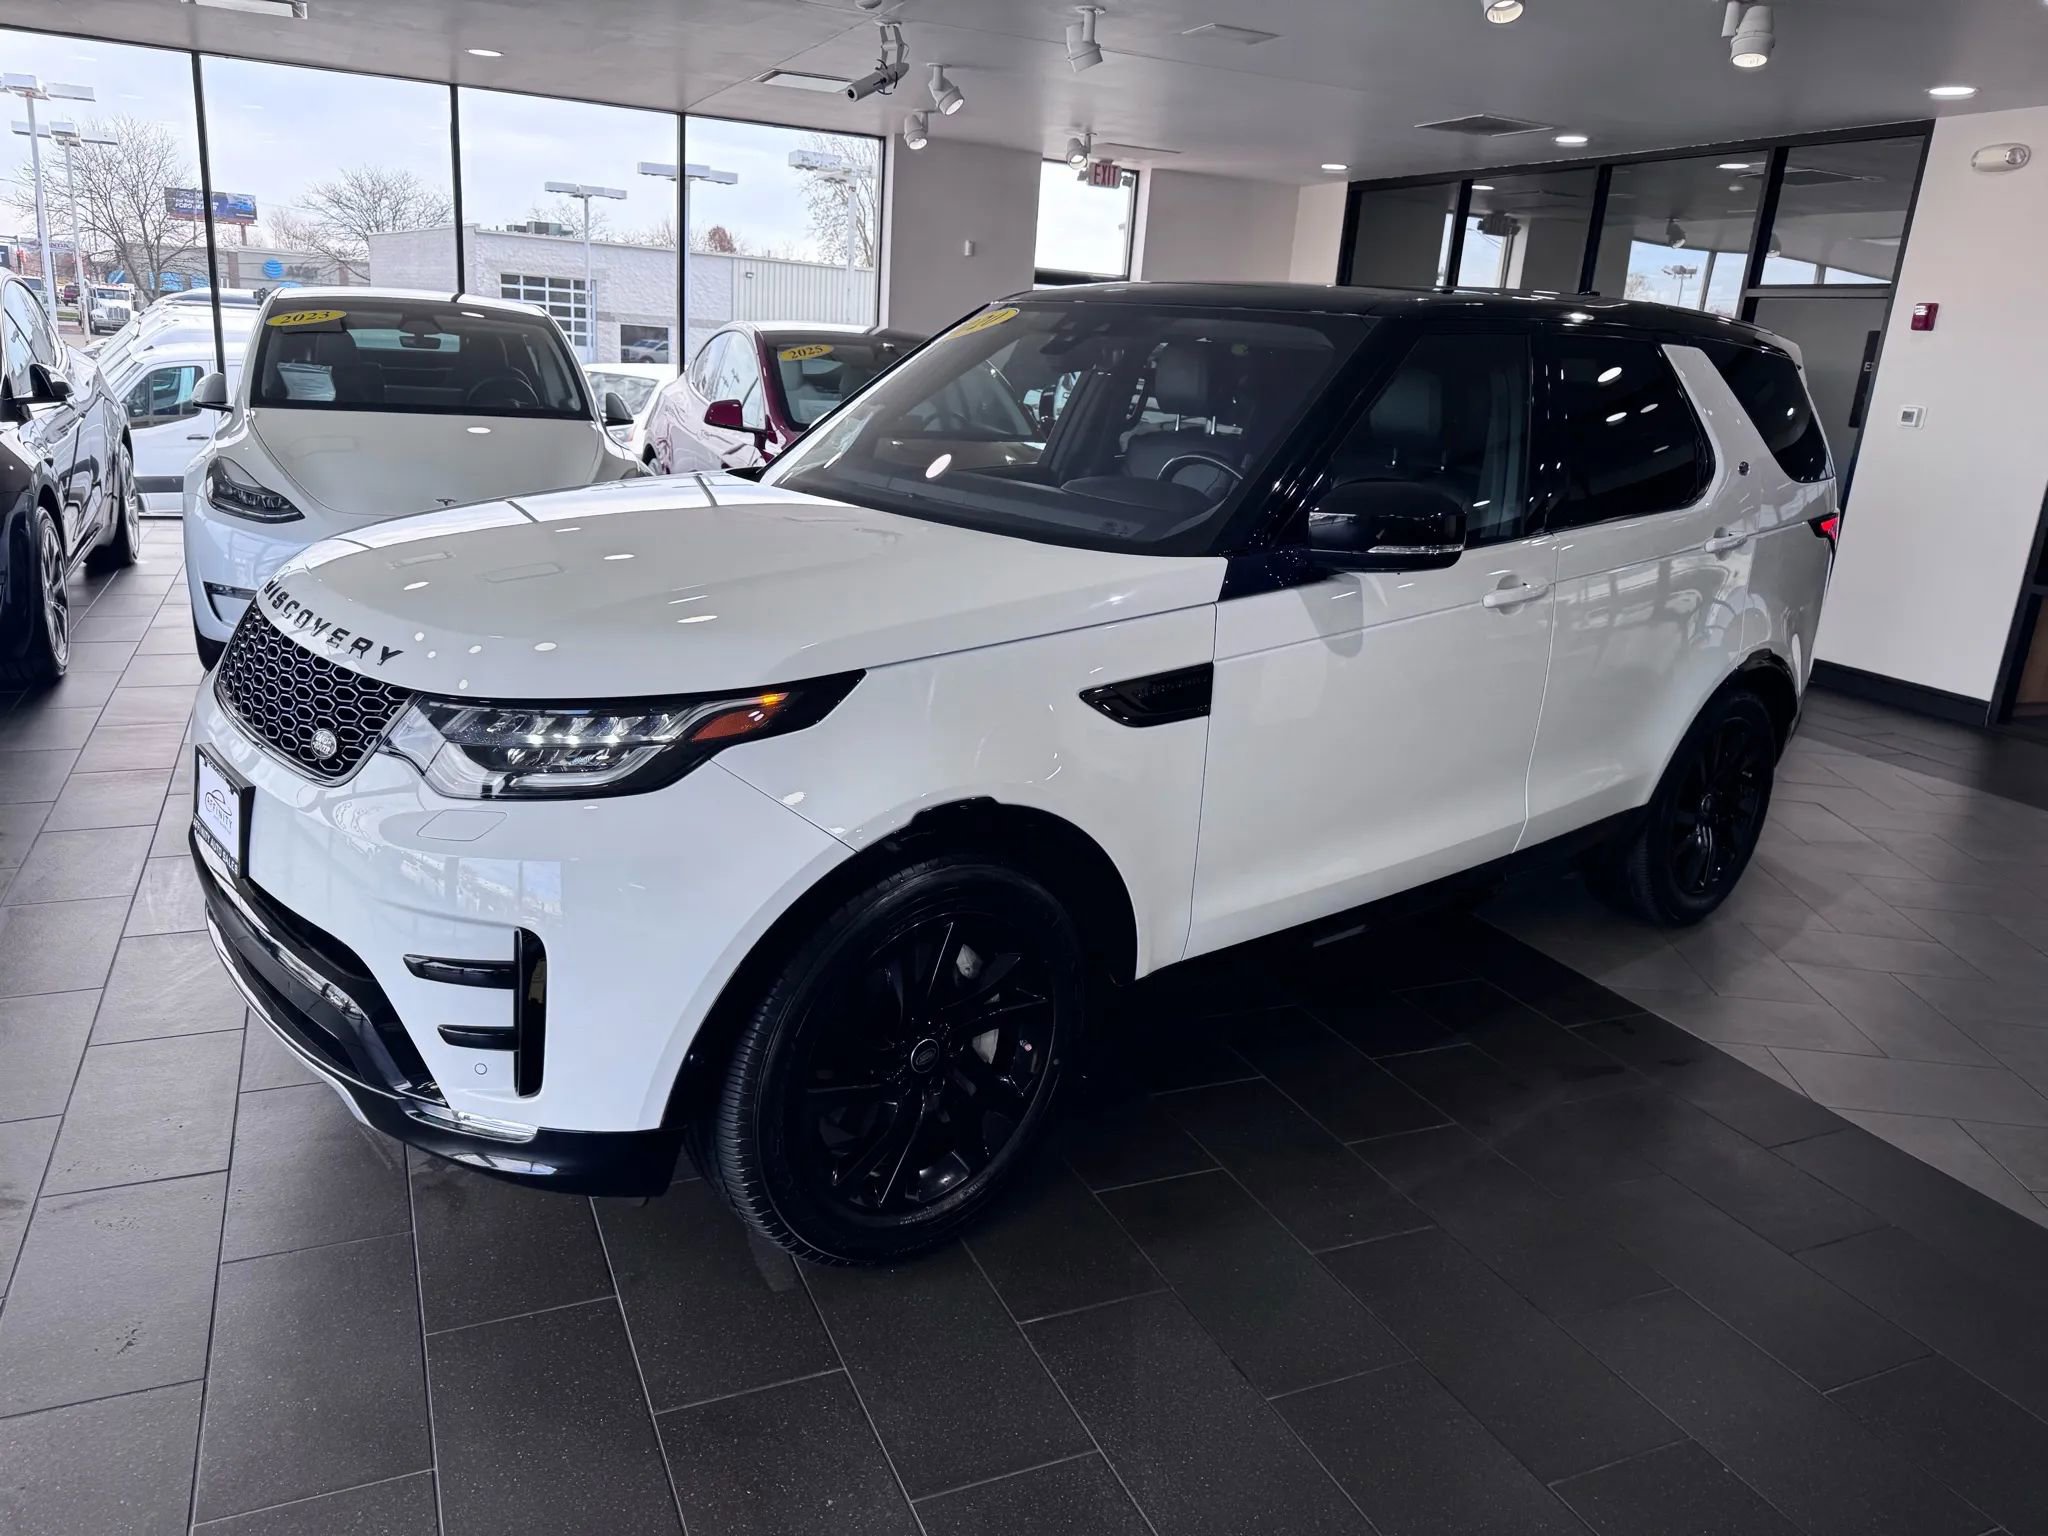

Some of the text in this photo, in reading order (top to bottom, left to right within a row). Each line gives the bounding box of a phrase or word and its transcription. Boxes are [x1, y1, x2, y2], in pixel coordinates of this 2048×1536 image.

[1094, 163, 1118, 186] EXIT
[280, 311, 330, 324] 2023
[789, 345, 823, 359] 2025
[264, 579, 404, 666] DISCOVERY
[207, 796, 233, 830] AFFINITY
[210, 836, 222, 859] AUTO
[222, 852, 238, 875] SALES
